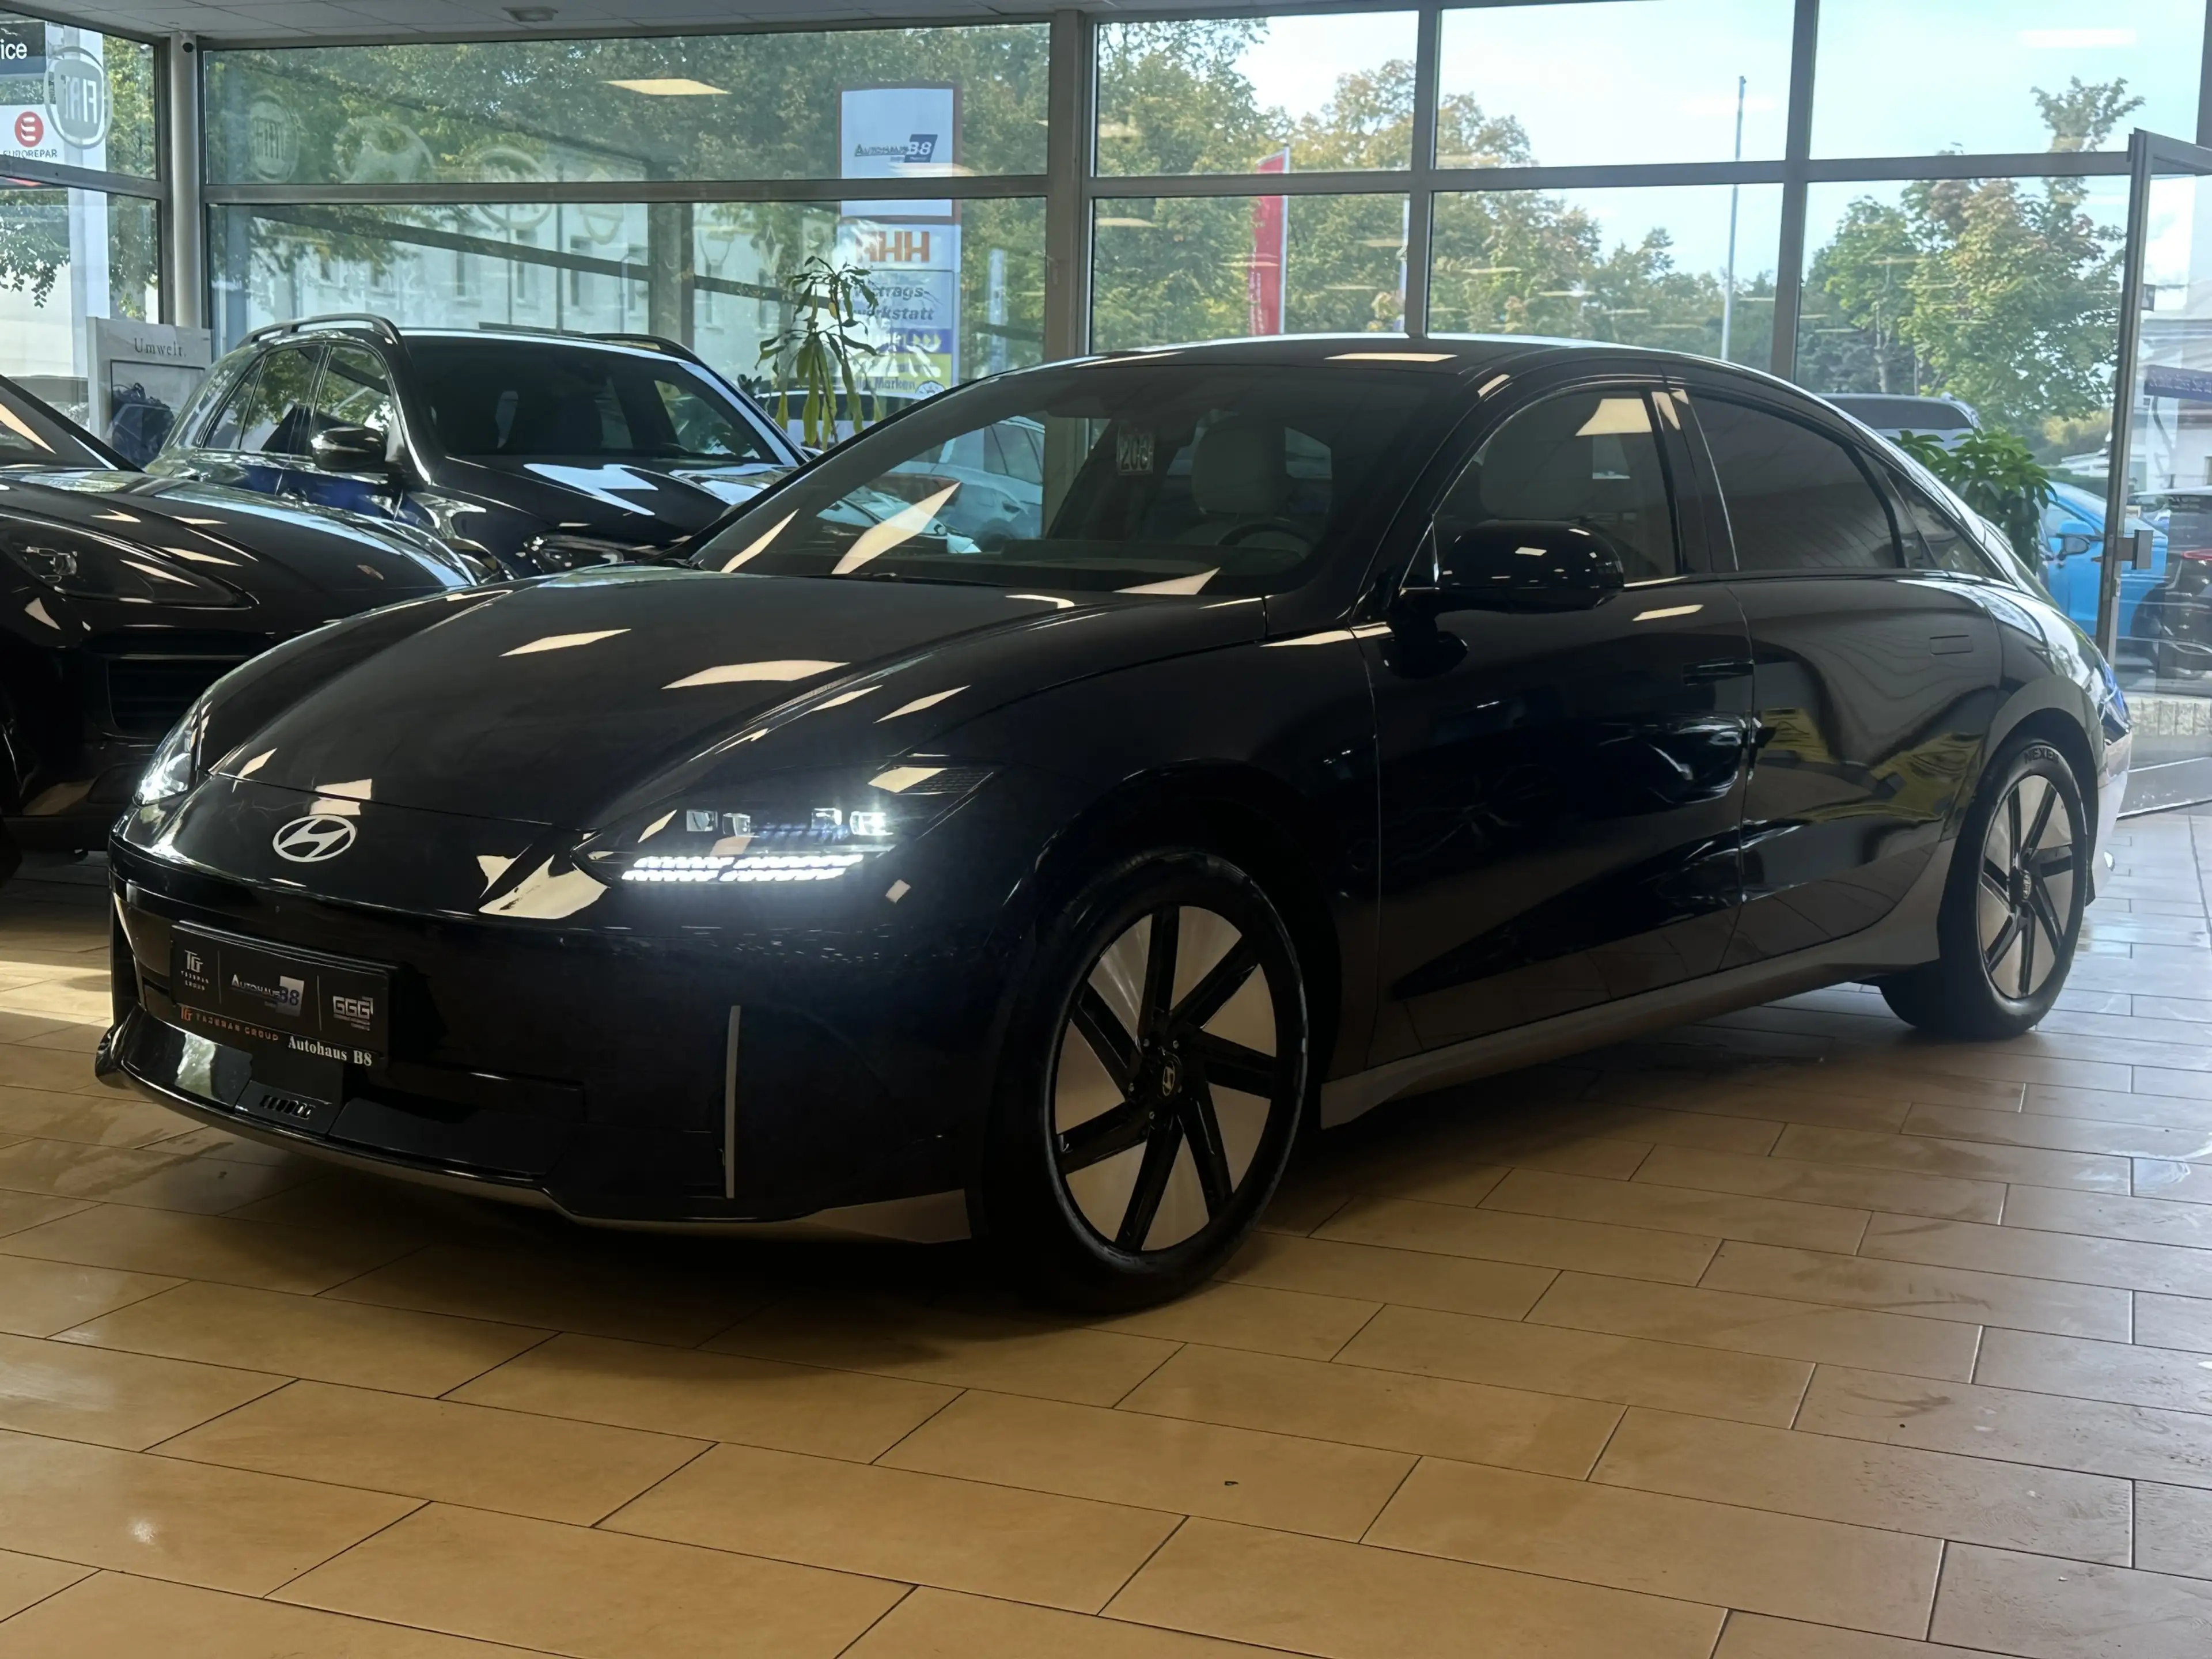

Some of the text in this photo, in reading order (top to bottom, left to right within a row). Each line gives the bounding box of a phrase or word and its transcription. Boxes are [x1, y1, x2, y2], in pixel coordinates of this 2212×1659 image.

[244, 1027, 279, 1041] GROUP
[287, 1035, 373, 1067] Autohaus B8
